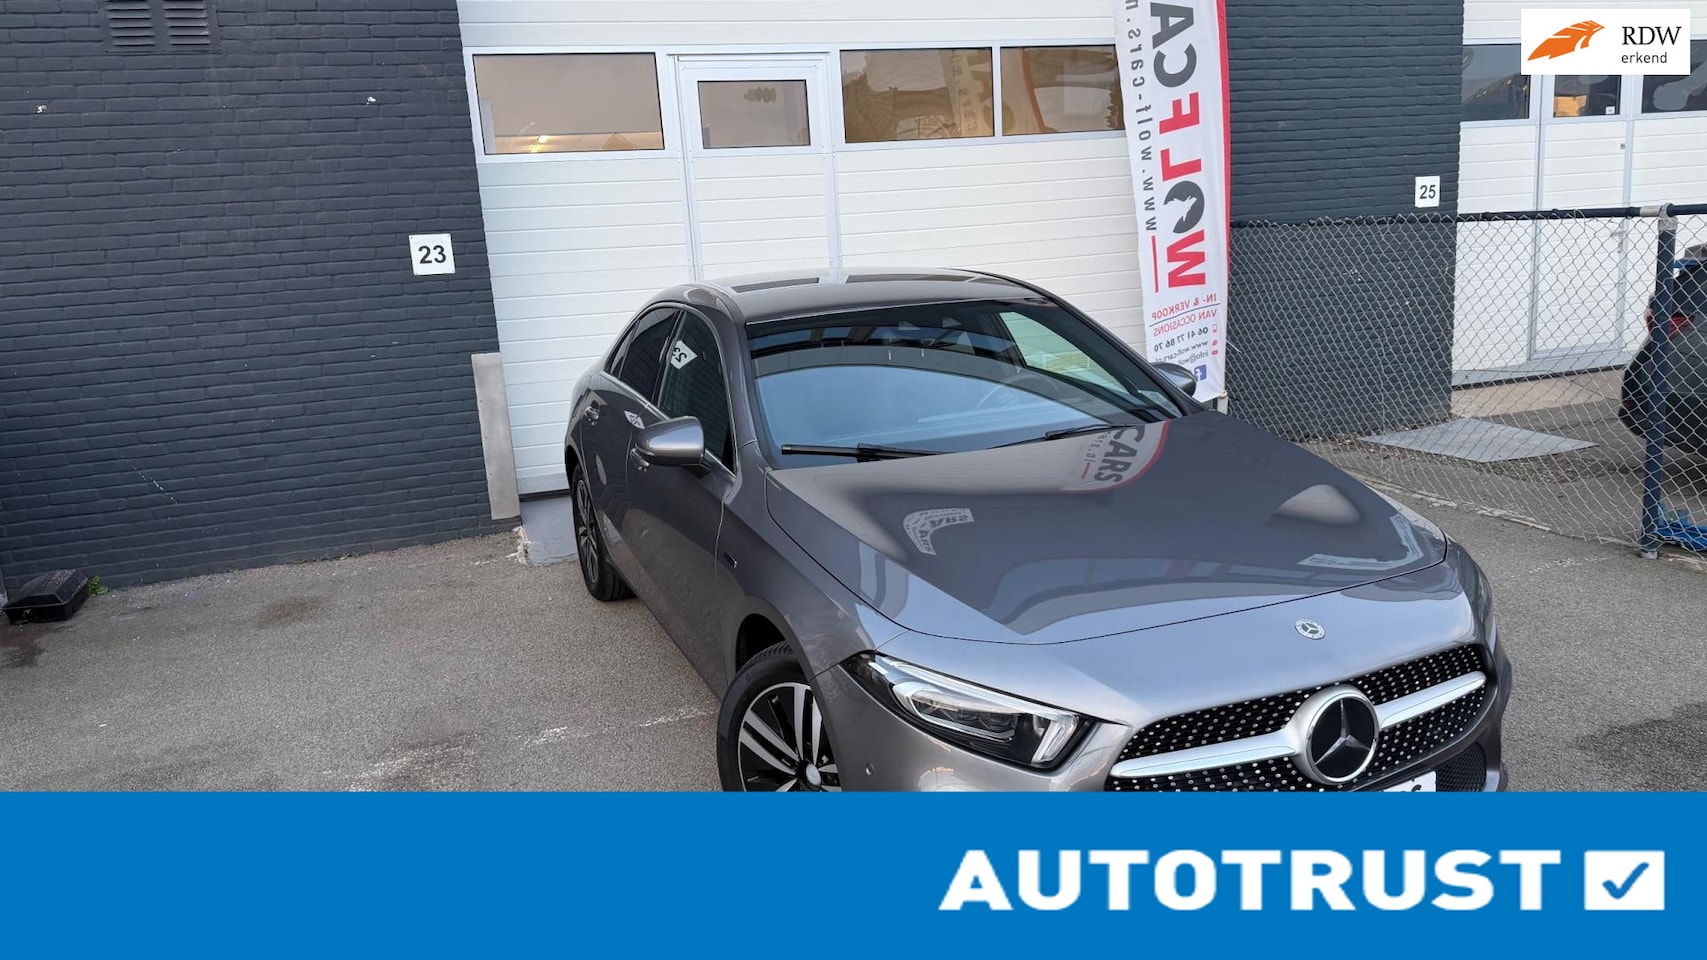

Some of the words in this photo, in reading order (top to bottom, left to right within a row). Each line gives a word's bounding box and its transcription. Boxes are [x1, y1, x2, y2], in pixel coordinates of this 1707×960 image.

[1419, 184, 1437, 200] 25
[418, 245, 447, 264] 23
[1093, 422, 1146, 483] CARS
